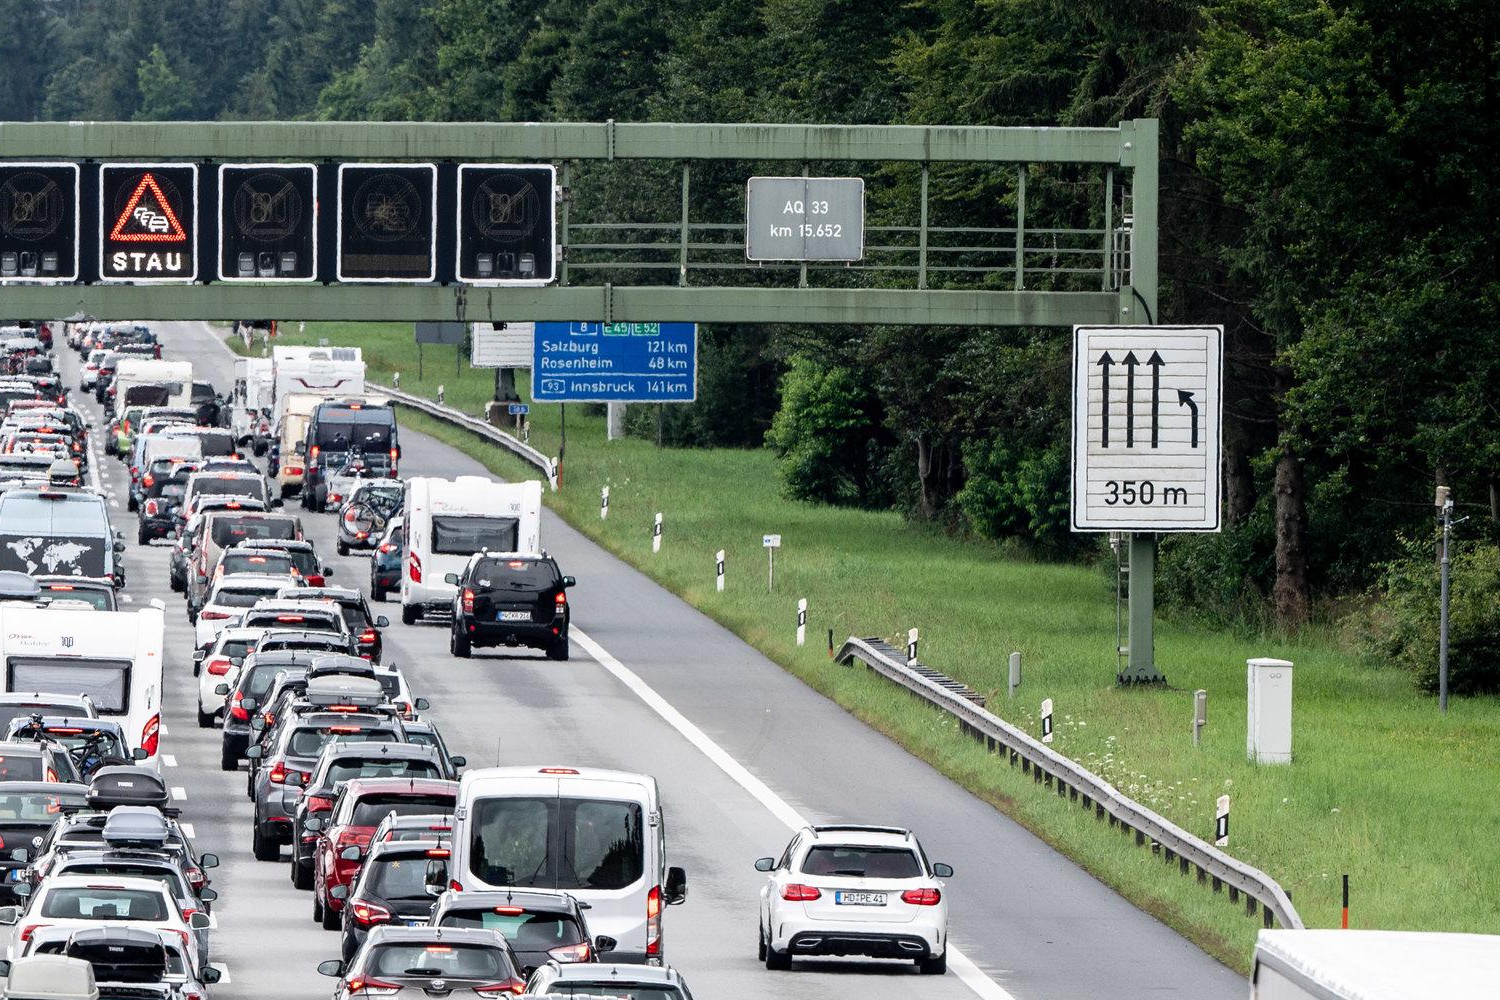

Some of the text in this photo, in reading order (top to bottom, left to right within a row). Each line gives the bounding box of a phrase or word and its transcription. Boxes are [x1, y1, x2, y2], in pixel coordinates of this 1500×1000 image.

[783, 200, 829, 215] AQ 33
[770, 224, 842, 238] km 15.652
[112, 251, 182, 271] STAU
[542, 340, 688, 354] Salzburg 121 km
[541, 357, 688, 369] Rosenheim 48 km
[547, 381, 688, 393] 93 Innsbruck 141 km
[1104, 480, 1188, 505] 350 m
[843, 893, 885, 904] HD PE 41
